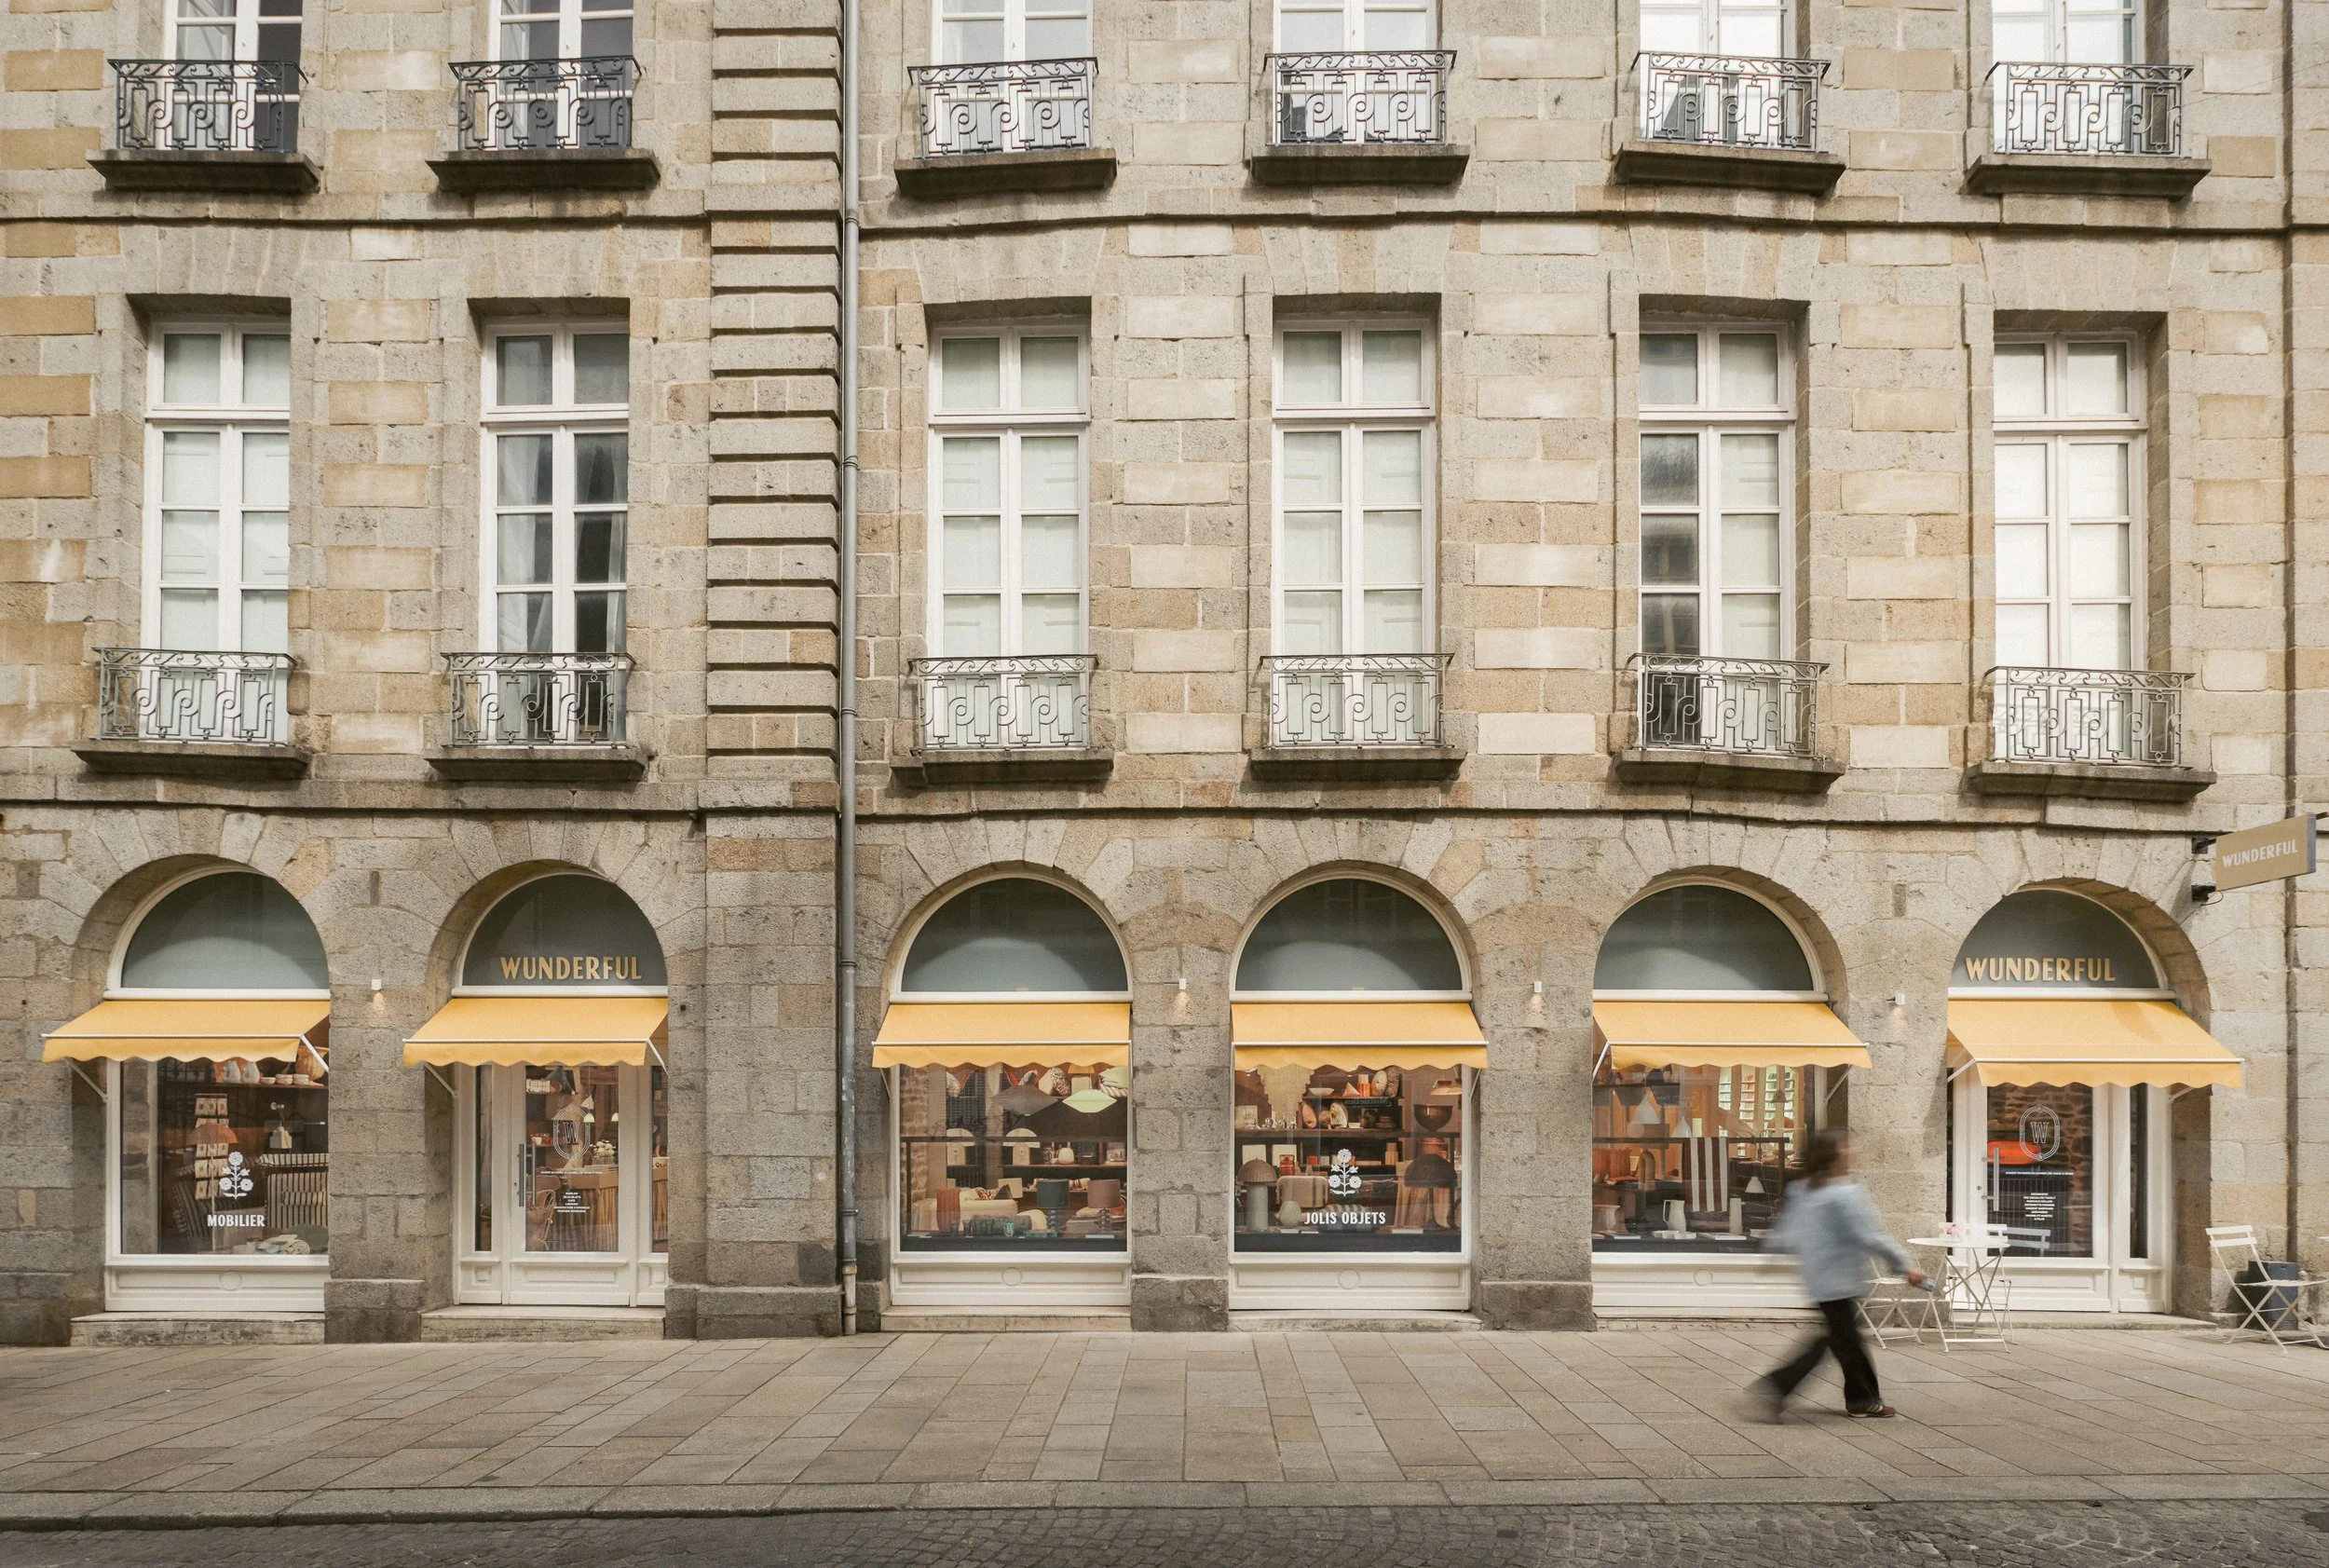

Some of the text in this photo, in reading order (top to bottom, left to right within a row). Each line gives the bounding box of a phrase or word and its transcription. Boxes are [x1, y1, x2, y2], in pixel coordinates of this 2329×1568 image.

[2222, 839, 2298, 868] WUNDERFUL
[500, 957, 642, 980] WUNDERFUL
[1966, 958, 2116, 981] WUNDERFUL
[563, 1122, 580, 1143] W
[2030, 1121, 2050, 1143] W
[207, 1214, 266, 1227] MOBILIER
[1304, 1212, 1386, 1224] JOLIS OBJETS
